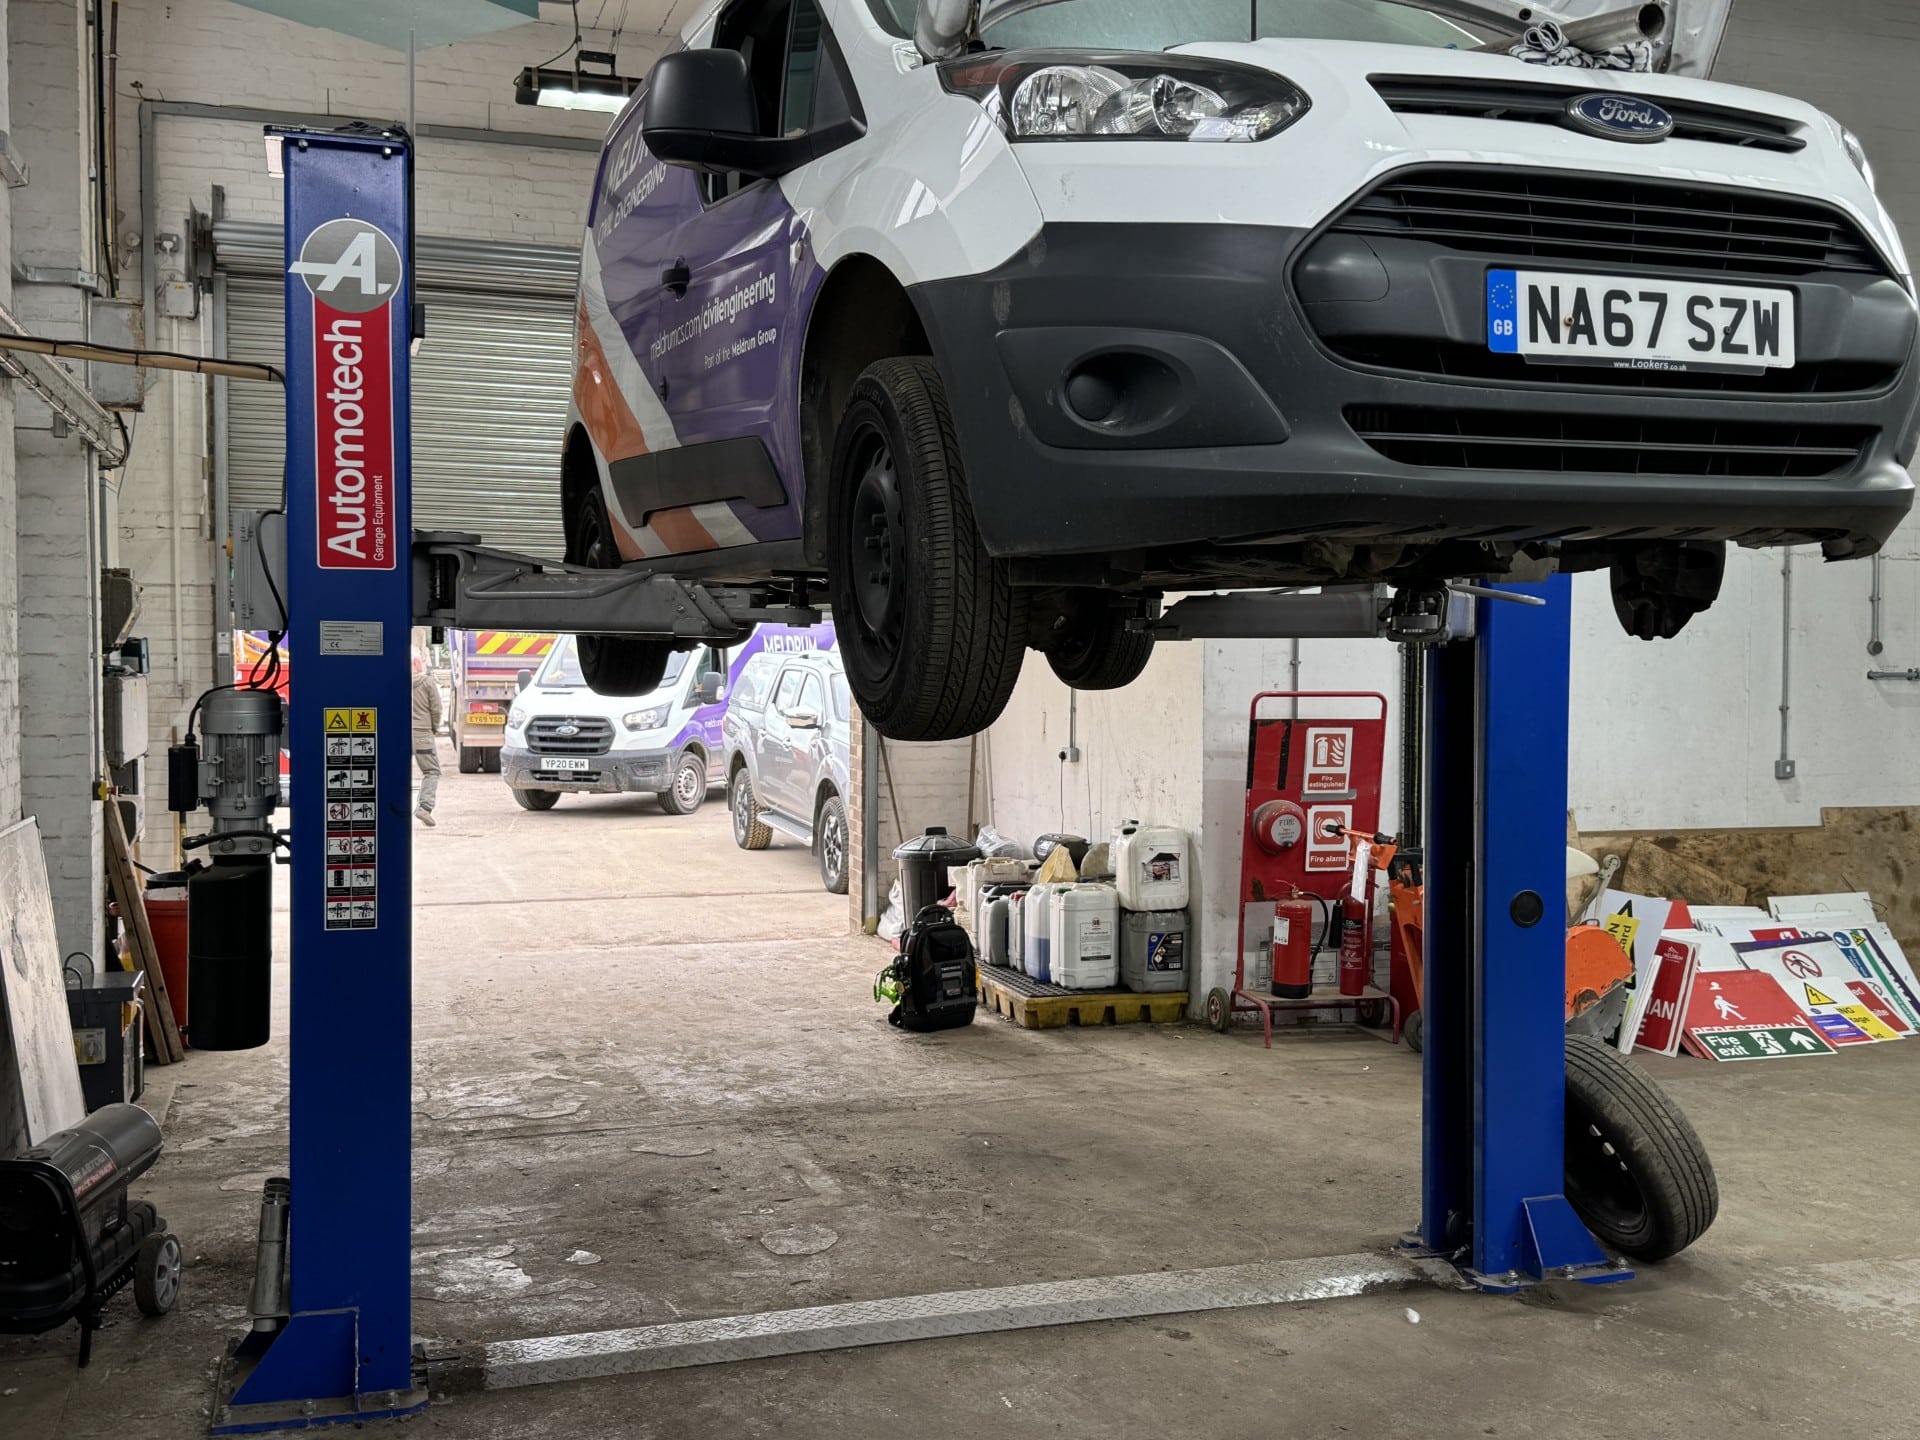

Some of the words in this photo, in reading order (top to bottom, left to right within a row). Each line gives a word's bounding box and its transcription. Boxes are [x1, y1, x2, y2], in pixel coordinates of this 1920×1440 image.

[1599, 98, 1654, 125] Ford
[614, 162, 667, 229] ENGINEERING
[650, 271, 776, 361] meldrumcs.com/civilengineering
[1493, 319, 1513, 336] GB
[1528, 284, 1668, 349] NA67
[1686, 295, 1780, 357] SZW
[704, 353, 715, 370] Part
[716, 350, 722, 365] of
[722, 346, 730, 361] the
[731, 336, 757, 358] Meldrum
[757, 327, 777, 345] Group
[1613, 358, 1687, 372] www.Lookers.co.uk
[324, 319, 366, 559] Automotech
[373, 475, 384, 524] Equipment
[373, 526, 384, 562] Garage
[545, 759, 567, 769] YP20
[1309, 781, 1345, 789] extinguisher
[1310, 855, 1324, 863] Fire
[1705, 1034, 1741, 1047] Fire
[1718, 1045, 1750, 1056] exit
